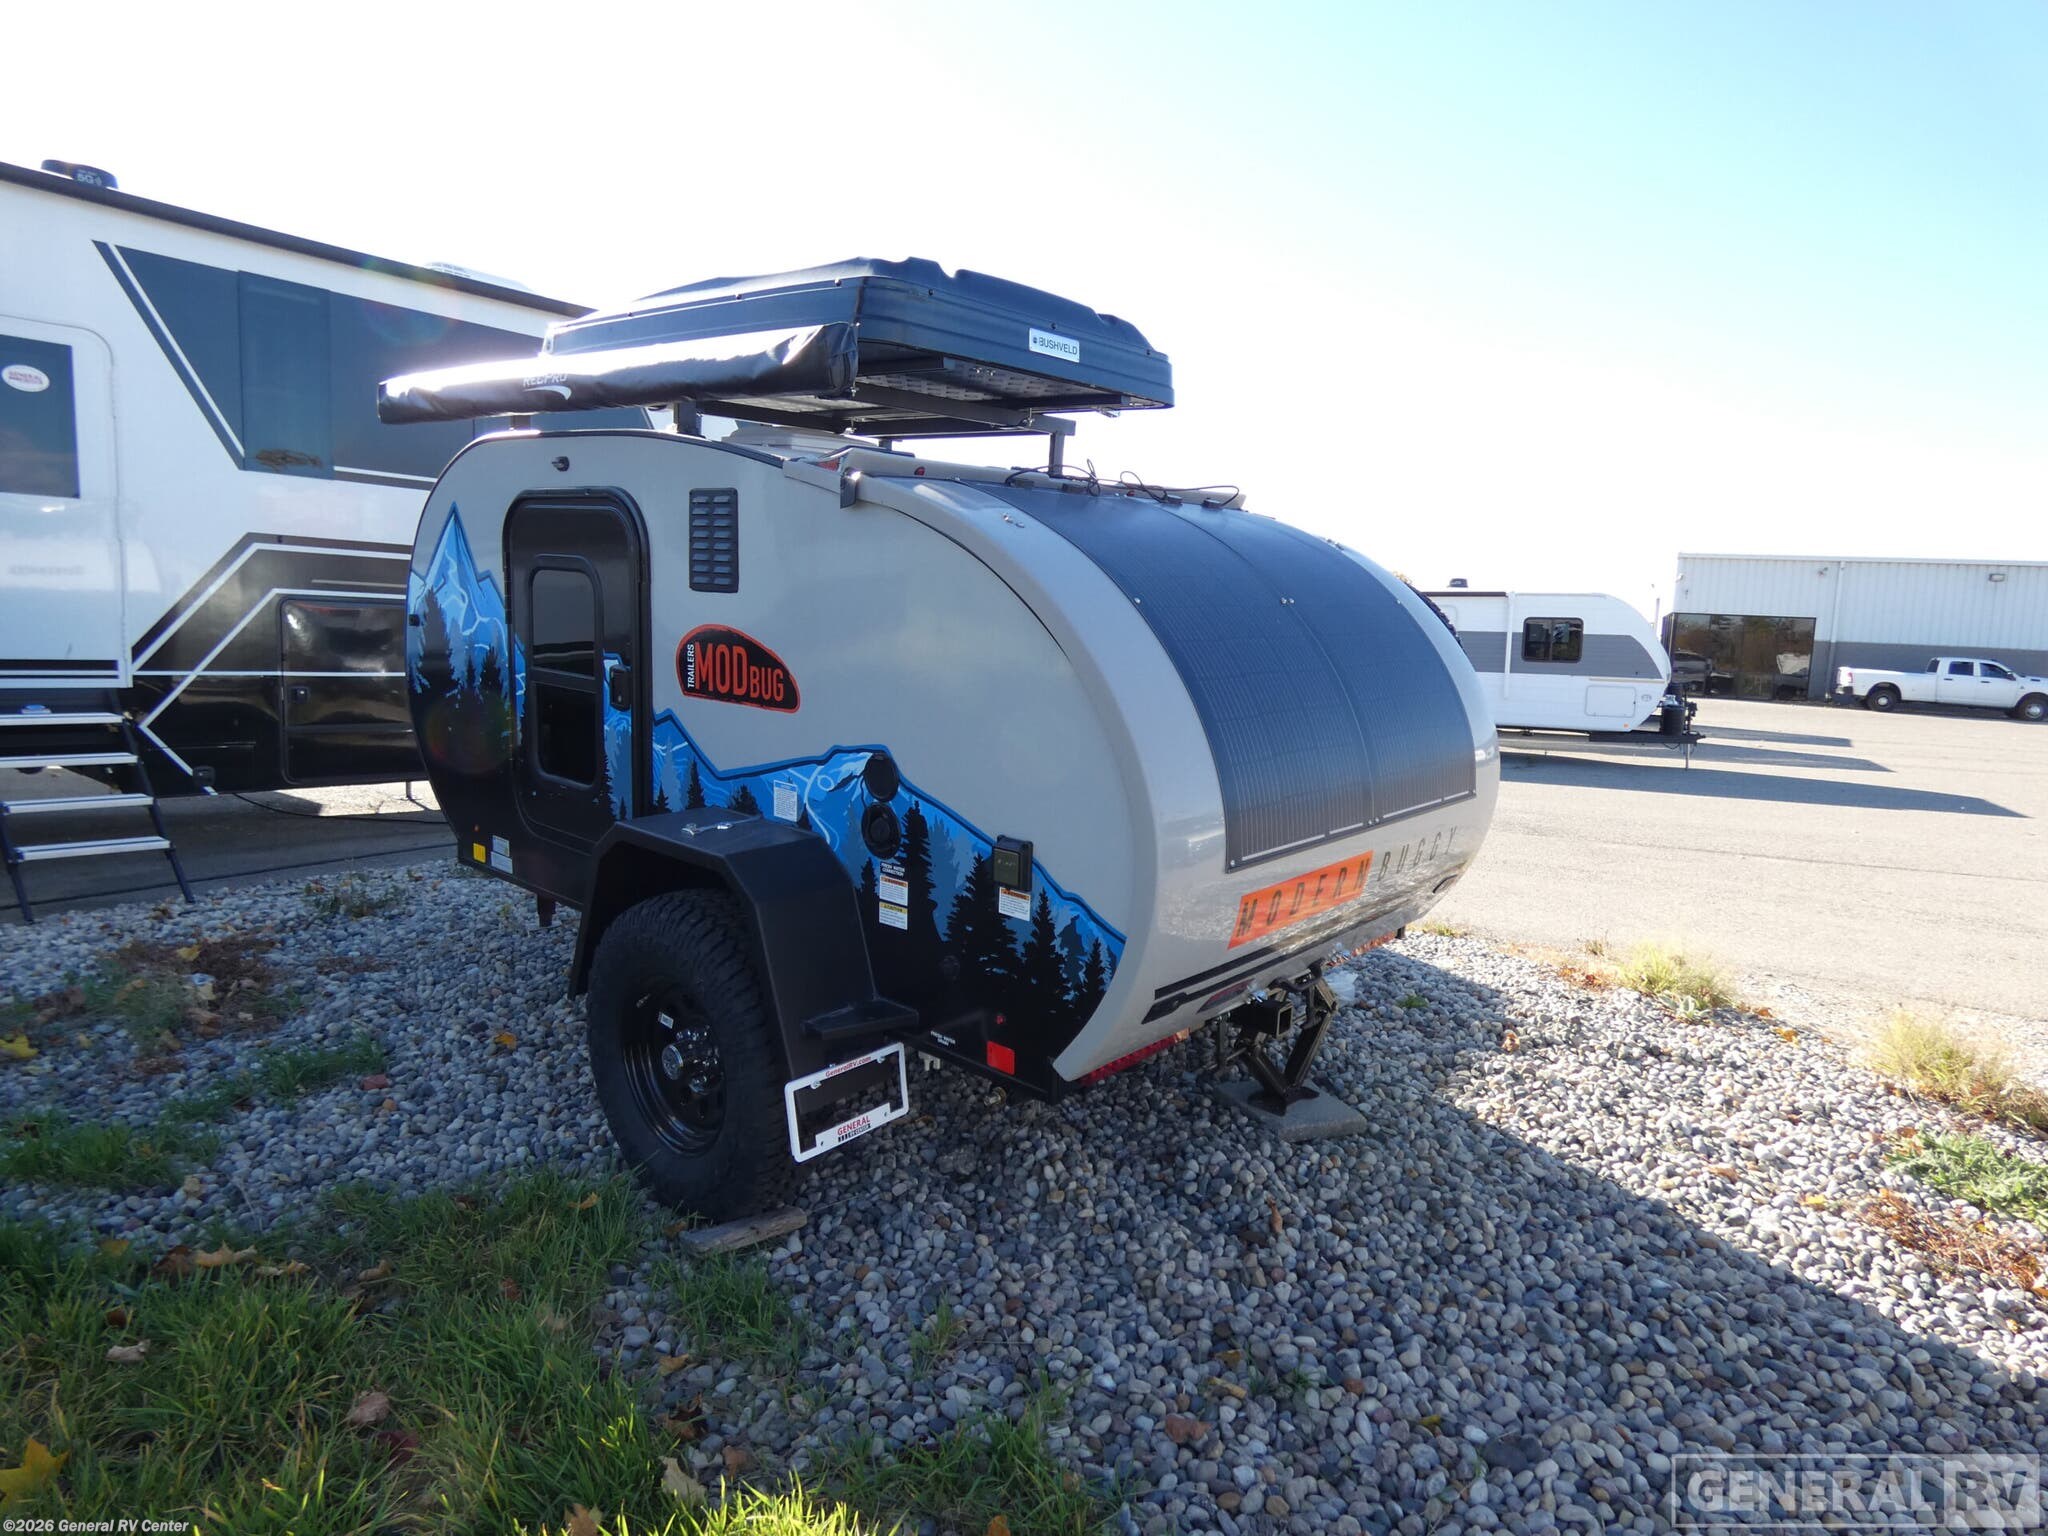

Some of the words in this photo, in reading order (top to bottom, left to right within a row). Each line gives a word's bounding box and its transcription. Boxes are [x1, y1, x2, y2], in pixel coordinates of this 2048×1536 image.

[1039, 337, 1078, 355] BUSHVELD
[687, 644, 695, 688] TRAILERS
[1236, 857, 1371, 937] MODERN
[1377, 826, 1457, 881] BUGGY
[825, 1057, 871, 1077] GeneralRV.com
[837, 1116, 871, 1135] GENERAL
